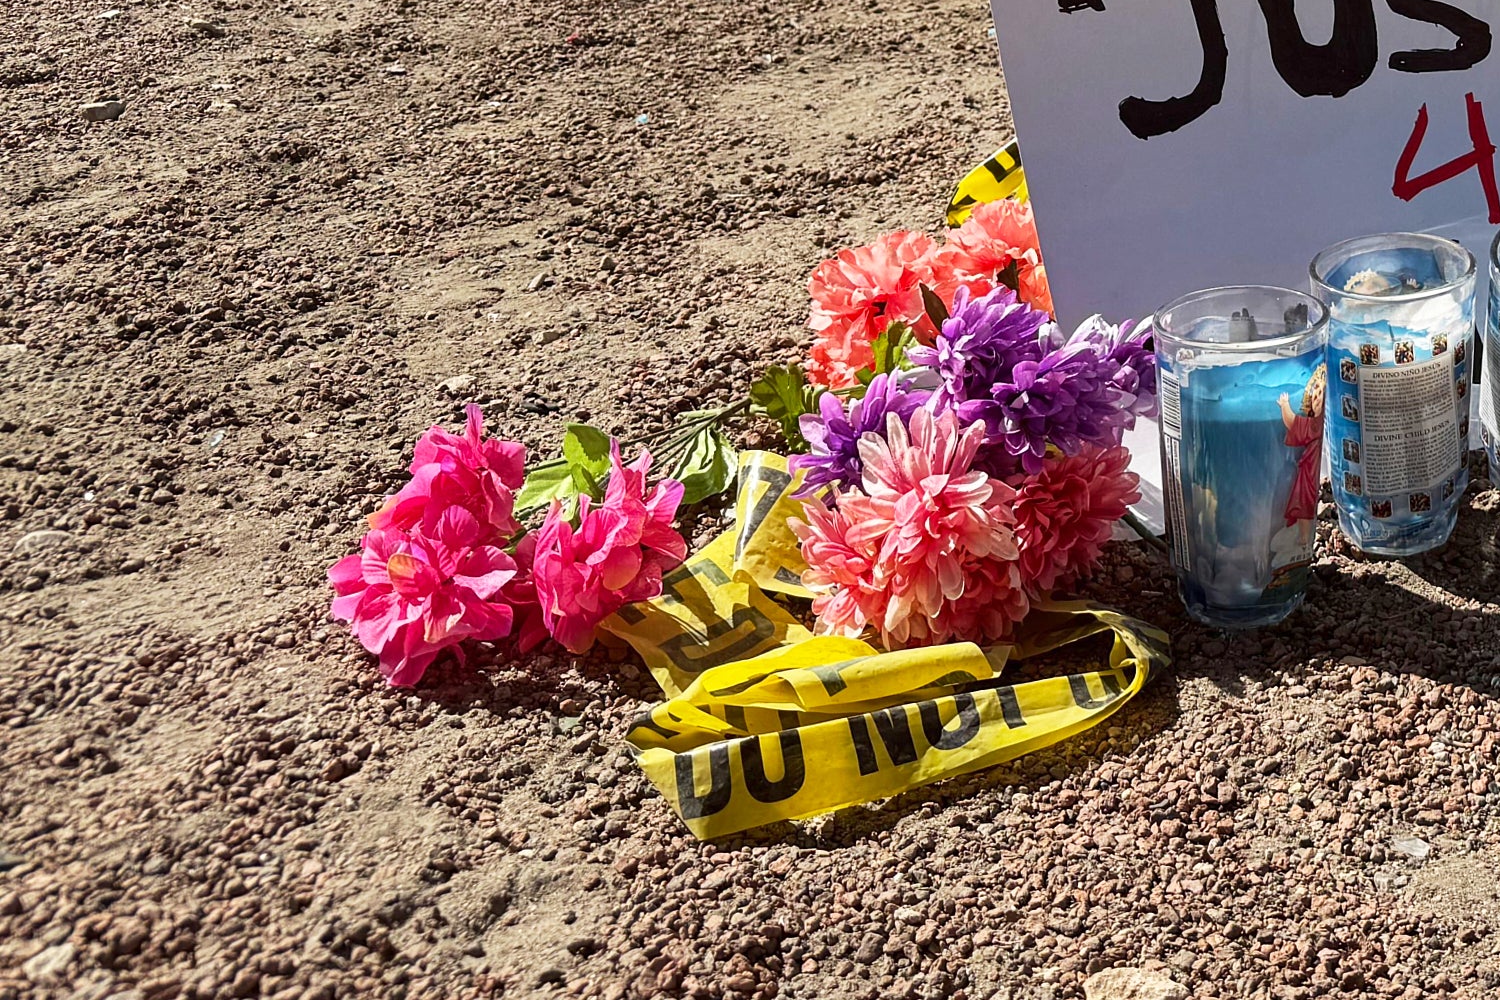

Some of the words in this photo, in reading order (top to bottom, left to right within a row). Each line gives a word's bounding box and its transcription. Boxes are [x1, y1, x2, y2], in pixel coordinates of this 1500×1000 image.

[1372, 370, 1400, 379] DIVINO
[1373, 433, 1402, 442] DIVINE
[1404, 427, 1430, 439] CHILD
[675, 727, 804, 821] DO
[847, 683, 1028, 777] NOT
